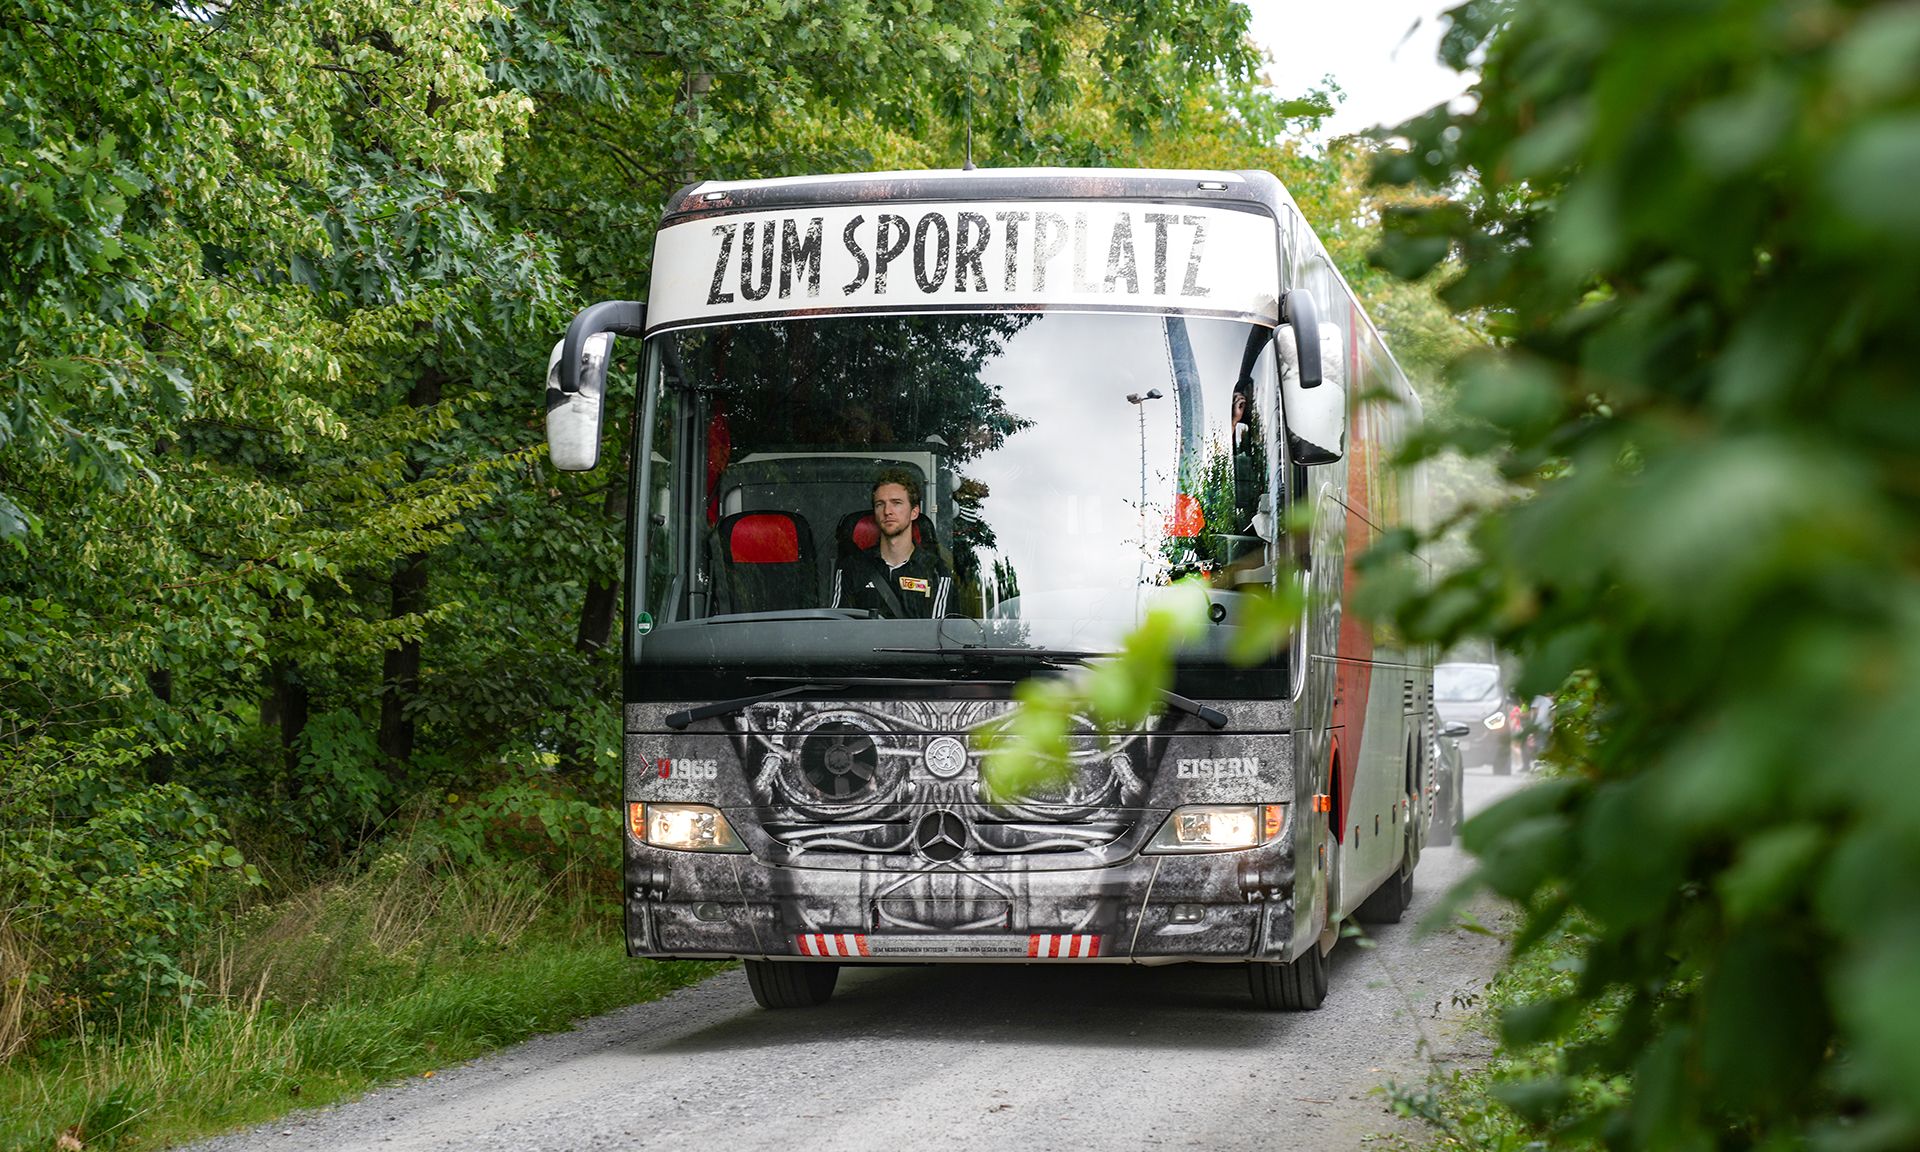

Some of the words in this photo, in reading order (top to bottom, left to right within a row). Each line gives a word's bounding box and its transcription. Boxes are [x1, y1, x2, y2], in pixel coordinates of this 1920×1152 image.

[707, 217, 824, 305] ZUM
[842, 211, 1211, 297] SPORTPLATZ
[1176, 757, 1259, 779] EISERN
